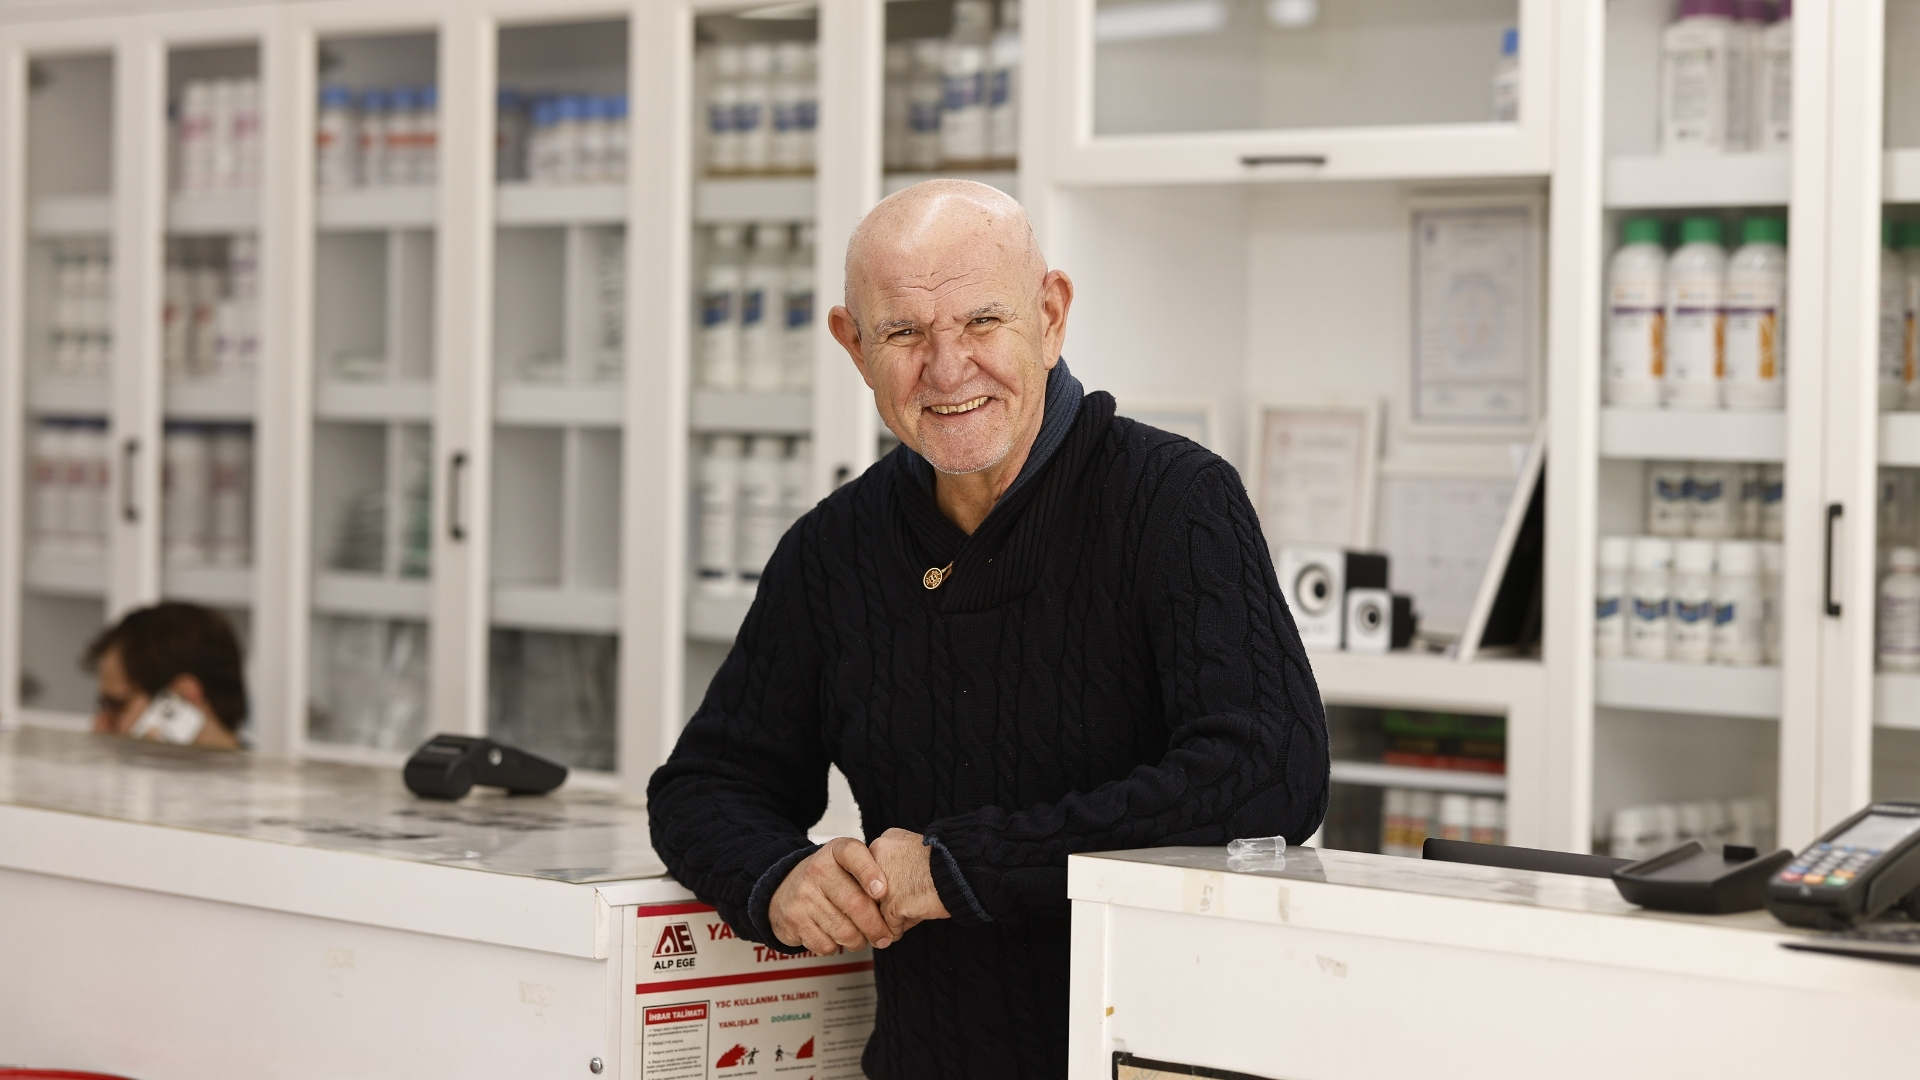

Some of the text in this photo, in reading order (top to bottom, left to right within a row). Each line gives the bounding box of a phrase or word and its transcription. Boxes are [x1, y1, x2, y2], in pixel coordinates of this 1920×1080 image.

[654, 957, 696, 970] ALP EGE
[733, 995, 779, 1007] KULLANMA
[781, 991, 819, 1002] TALİMATI
[648, 1009, 704, 1021] İHBAR TALİMATI
[770, 1012, 811, 1023] DOĞRULAR
[718, 1018, 759, 1029] YANLIŞLAR
